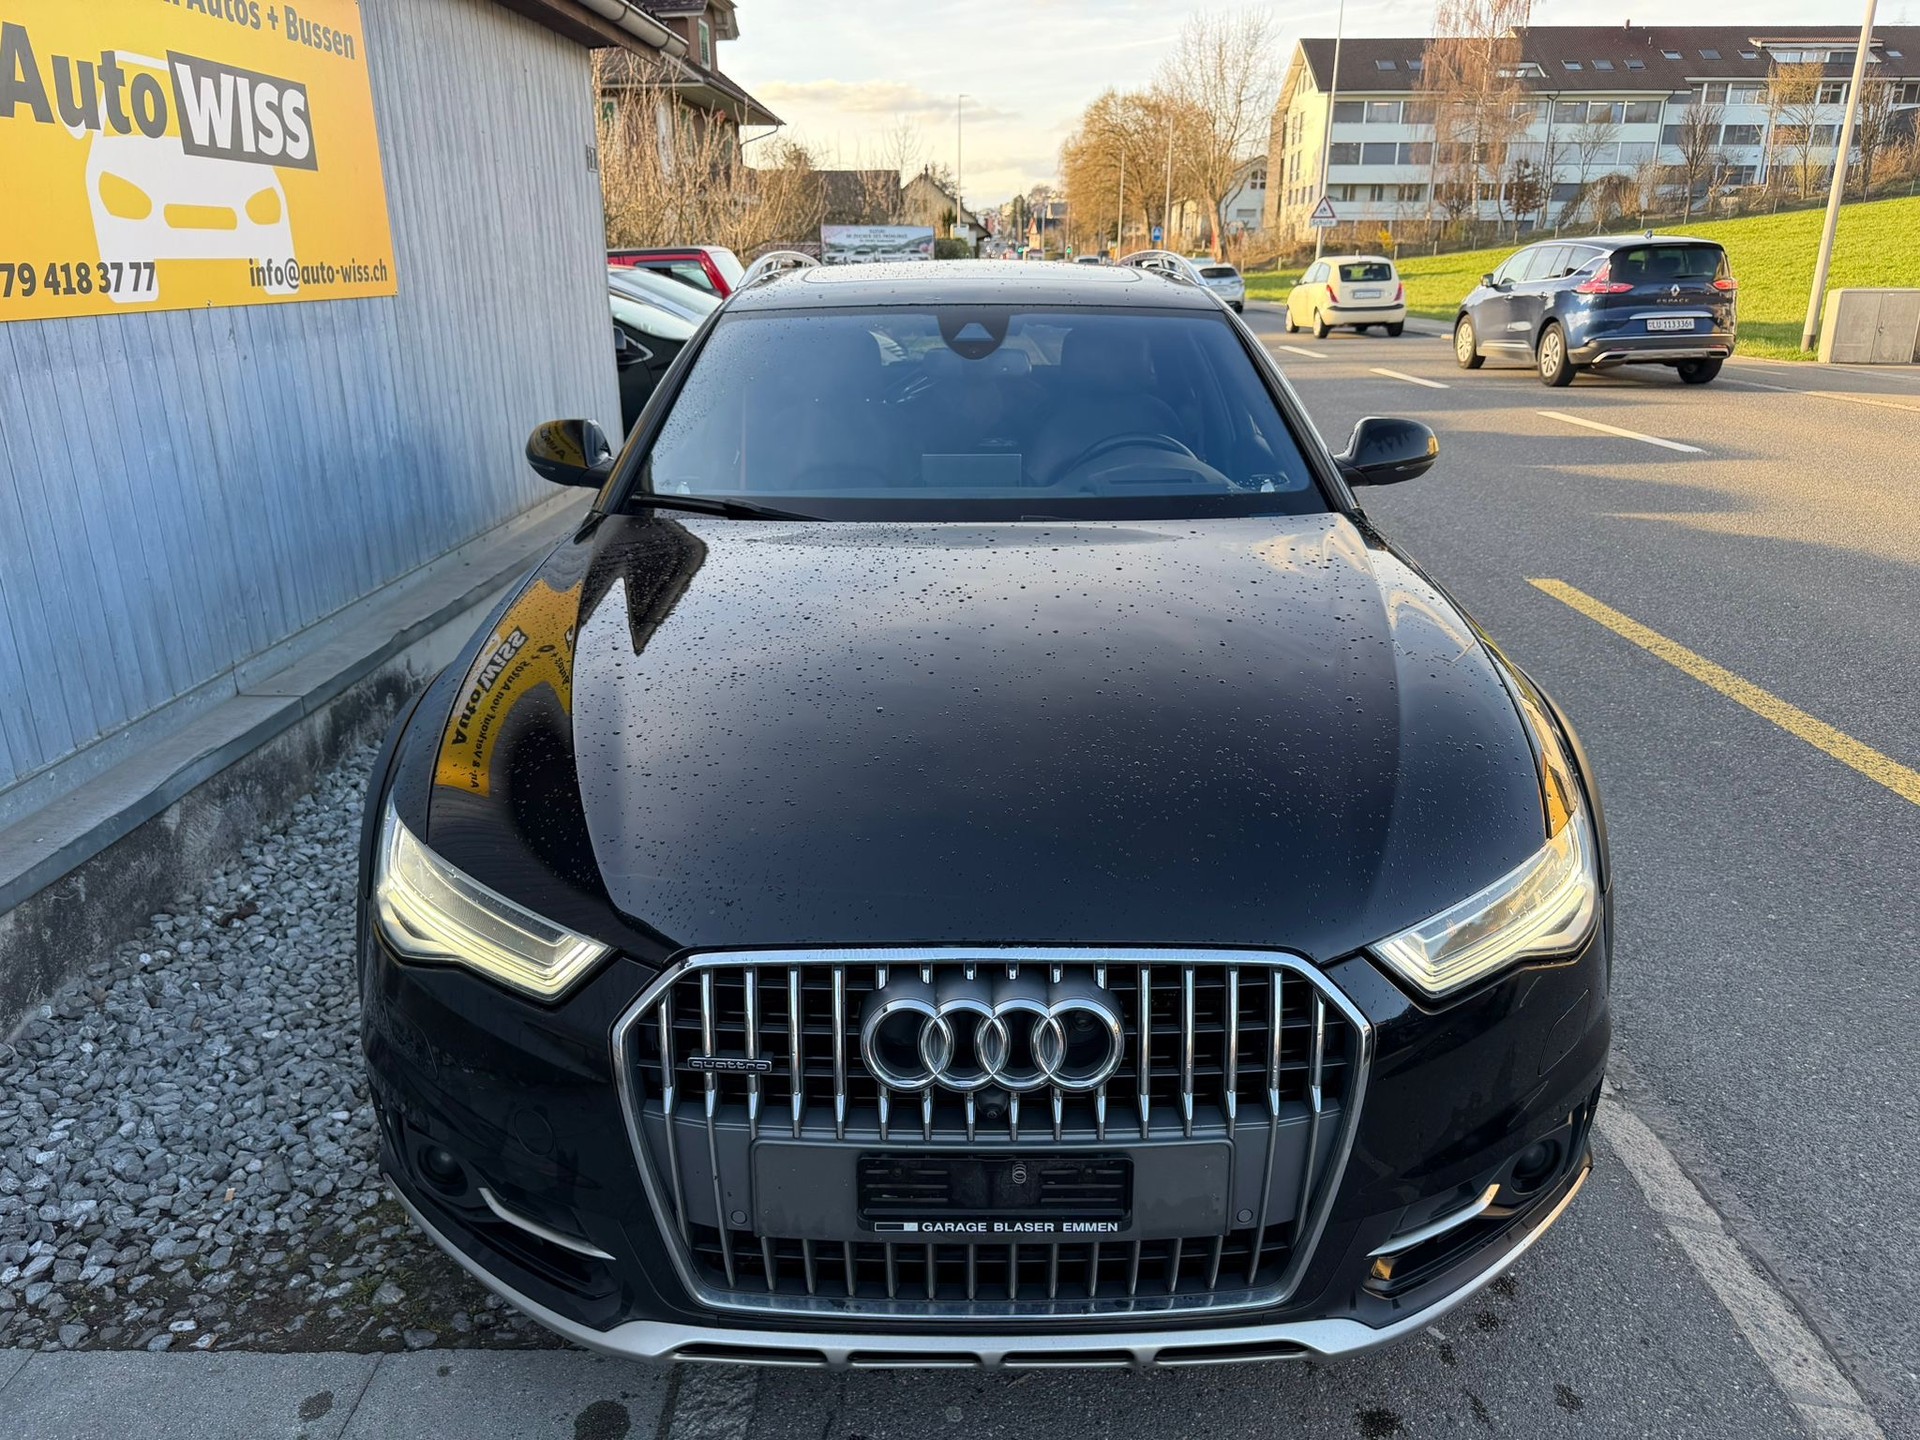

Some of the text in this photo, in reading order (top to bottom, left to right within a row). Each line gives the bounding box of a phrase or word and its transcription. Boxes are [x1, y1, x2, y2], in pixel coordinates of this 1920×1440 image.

[267, 6, 279, 30] +
[284, 5, 355, 59] Bussen
[0, 262, 155, 297] 79 418 37 77
[249, 258, 388, 289] info@auto-wiss.ch
[691, 1060, 767, 1070] quattro
[922, 1222, 1118, 1232] GARAGE BLASER EMMEN
